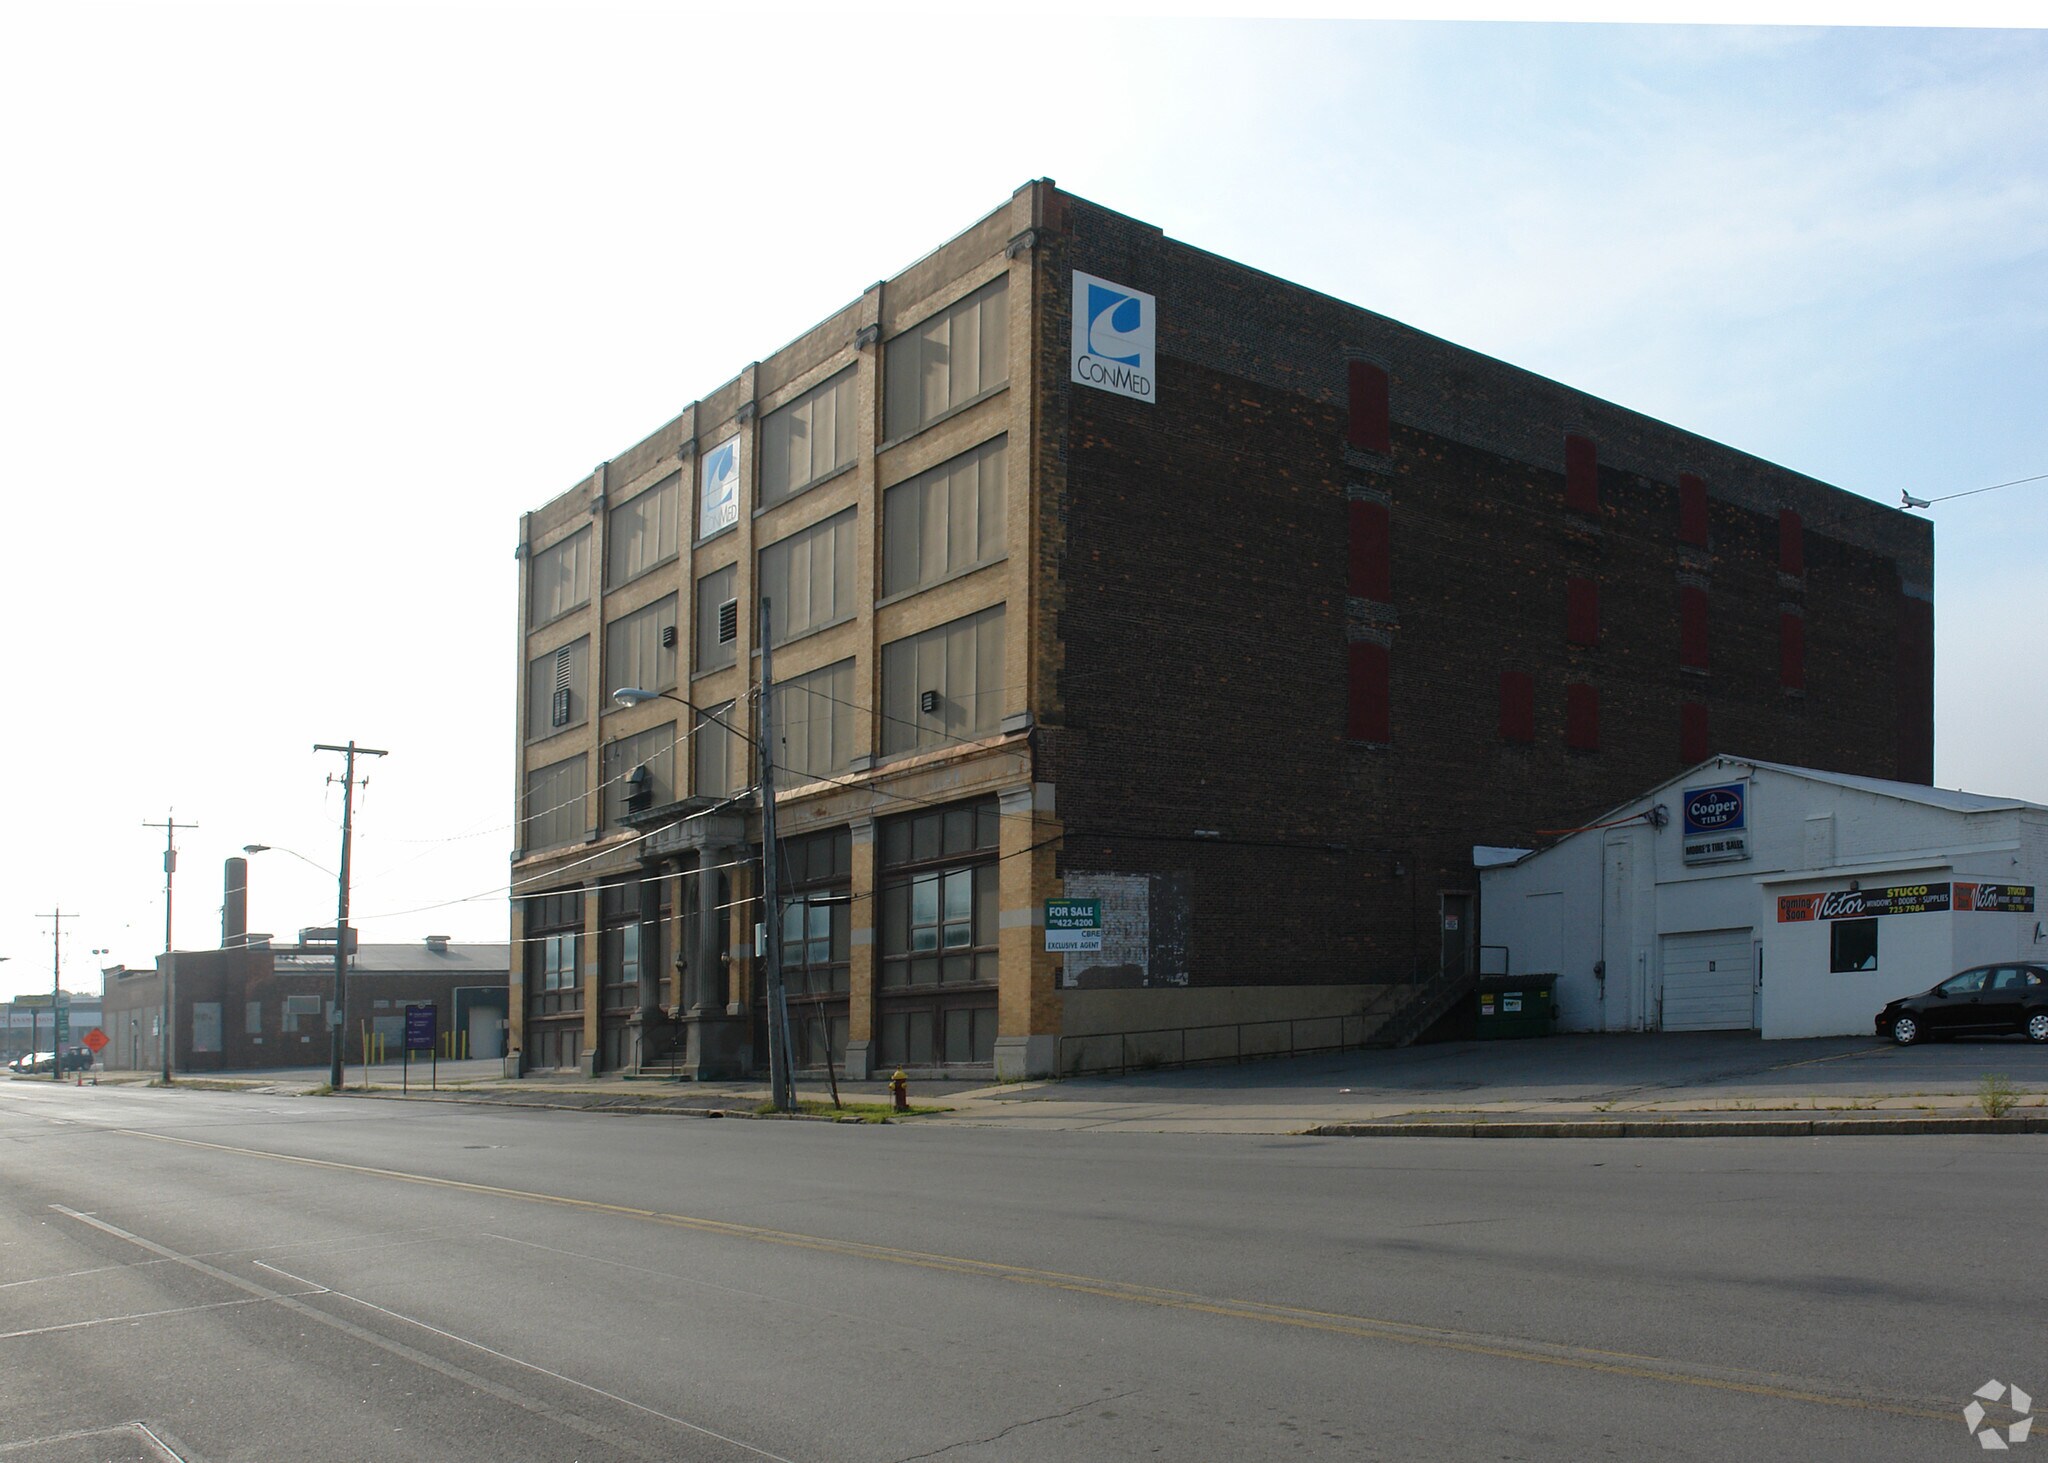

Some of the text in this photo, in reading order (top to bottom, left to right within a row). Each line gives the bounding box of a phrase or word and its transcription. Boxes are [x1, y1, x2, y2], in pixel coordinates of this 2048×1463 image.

[1691, 800, 1737, 815] Cooper
[1701, 814, 1727, 824] TIRES
[1711, 842, 1725, 852] TIRE
[1887, 886, 1928, 898] STUCCO
[1898, 897, 1917, 905] DOORS
[1922, 894, 1949, 903] SUPPLIES
[1970, 884, 1998, 911] Victor
[1780, 898, 1811, 909] Coming
[1811, 891, 1866, 921] Victor
[1049, 906, 1094, 916] FOR SALE
[1786, 910, 1806, 920] Soon
[1081, 930, 1101, 938] CBRE
[1080, 941, 1099, 949] AGENT
